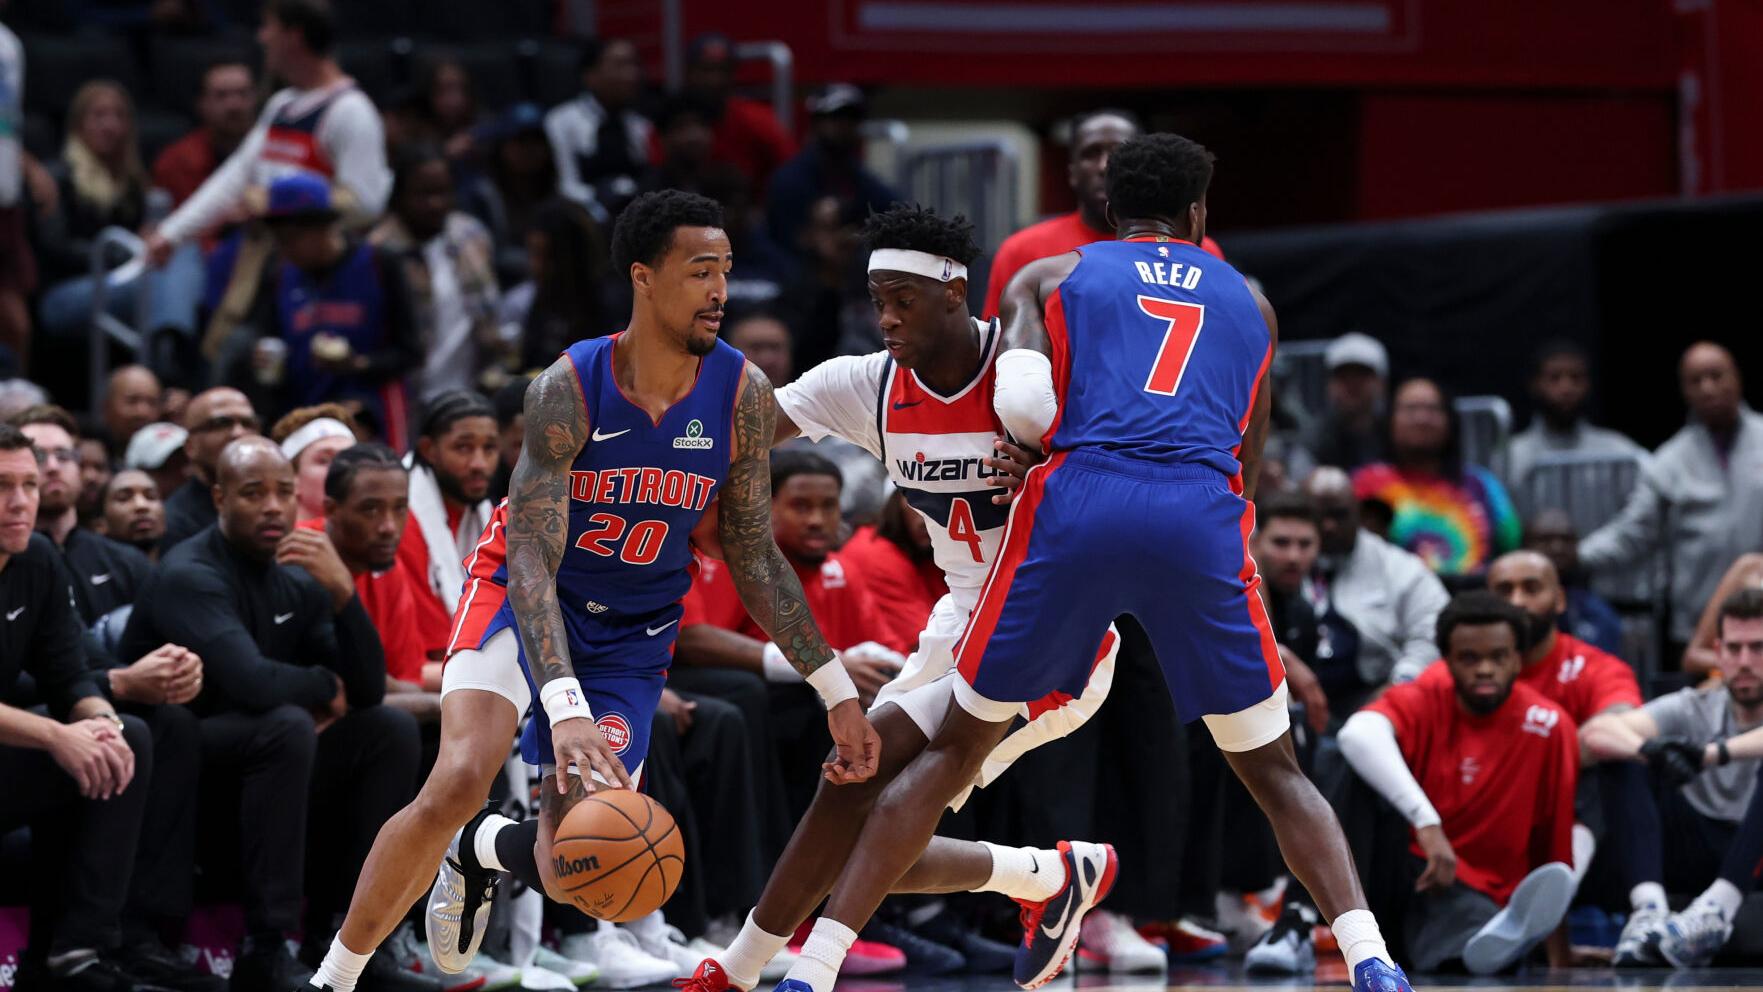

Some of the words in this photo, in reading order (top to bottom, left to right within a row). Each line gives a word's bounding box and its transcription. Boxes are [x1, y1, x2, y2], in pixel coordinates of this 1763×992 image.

[1134, 261, 1202, 290] REED
[1137, 294, 1205, 397] 7
[675, 438, 712, 447] StockX
[569, 466, 716, 511] DETROIT
[575, 512, 669, 565] 20
[946, 497, 986, 564] 4
[599, 724, 625, 738] DETROIT
[601, 731, 624, 745] ISTONS
